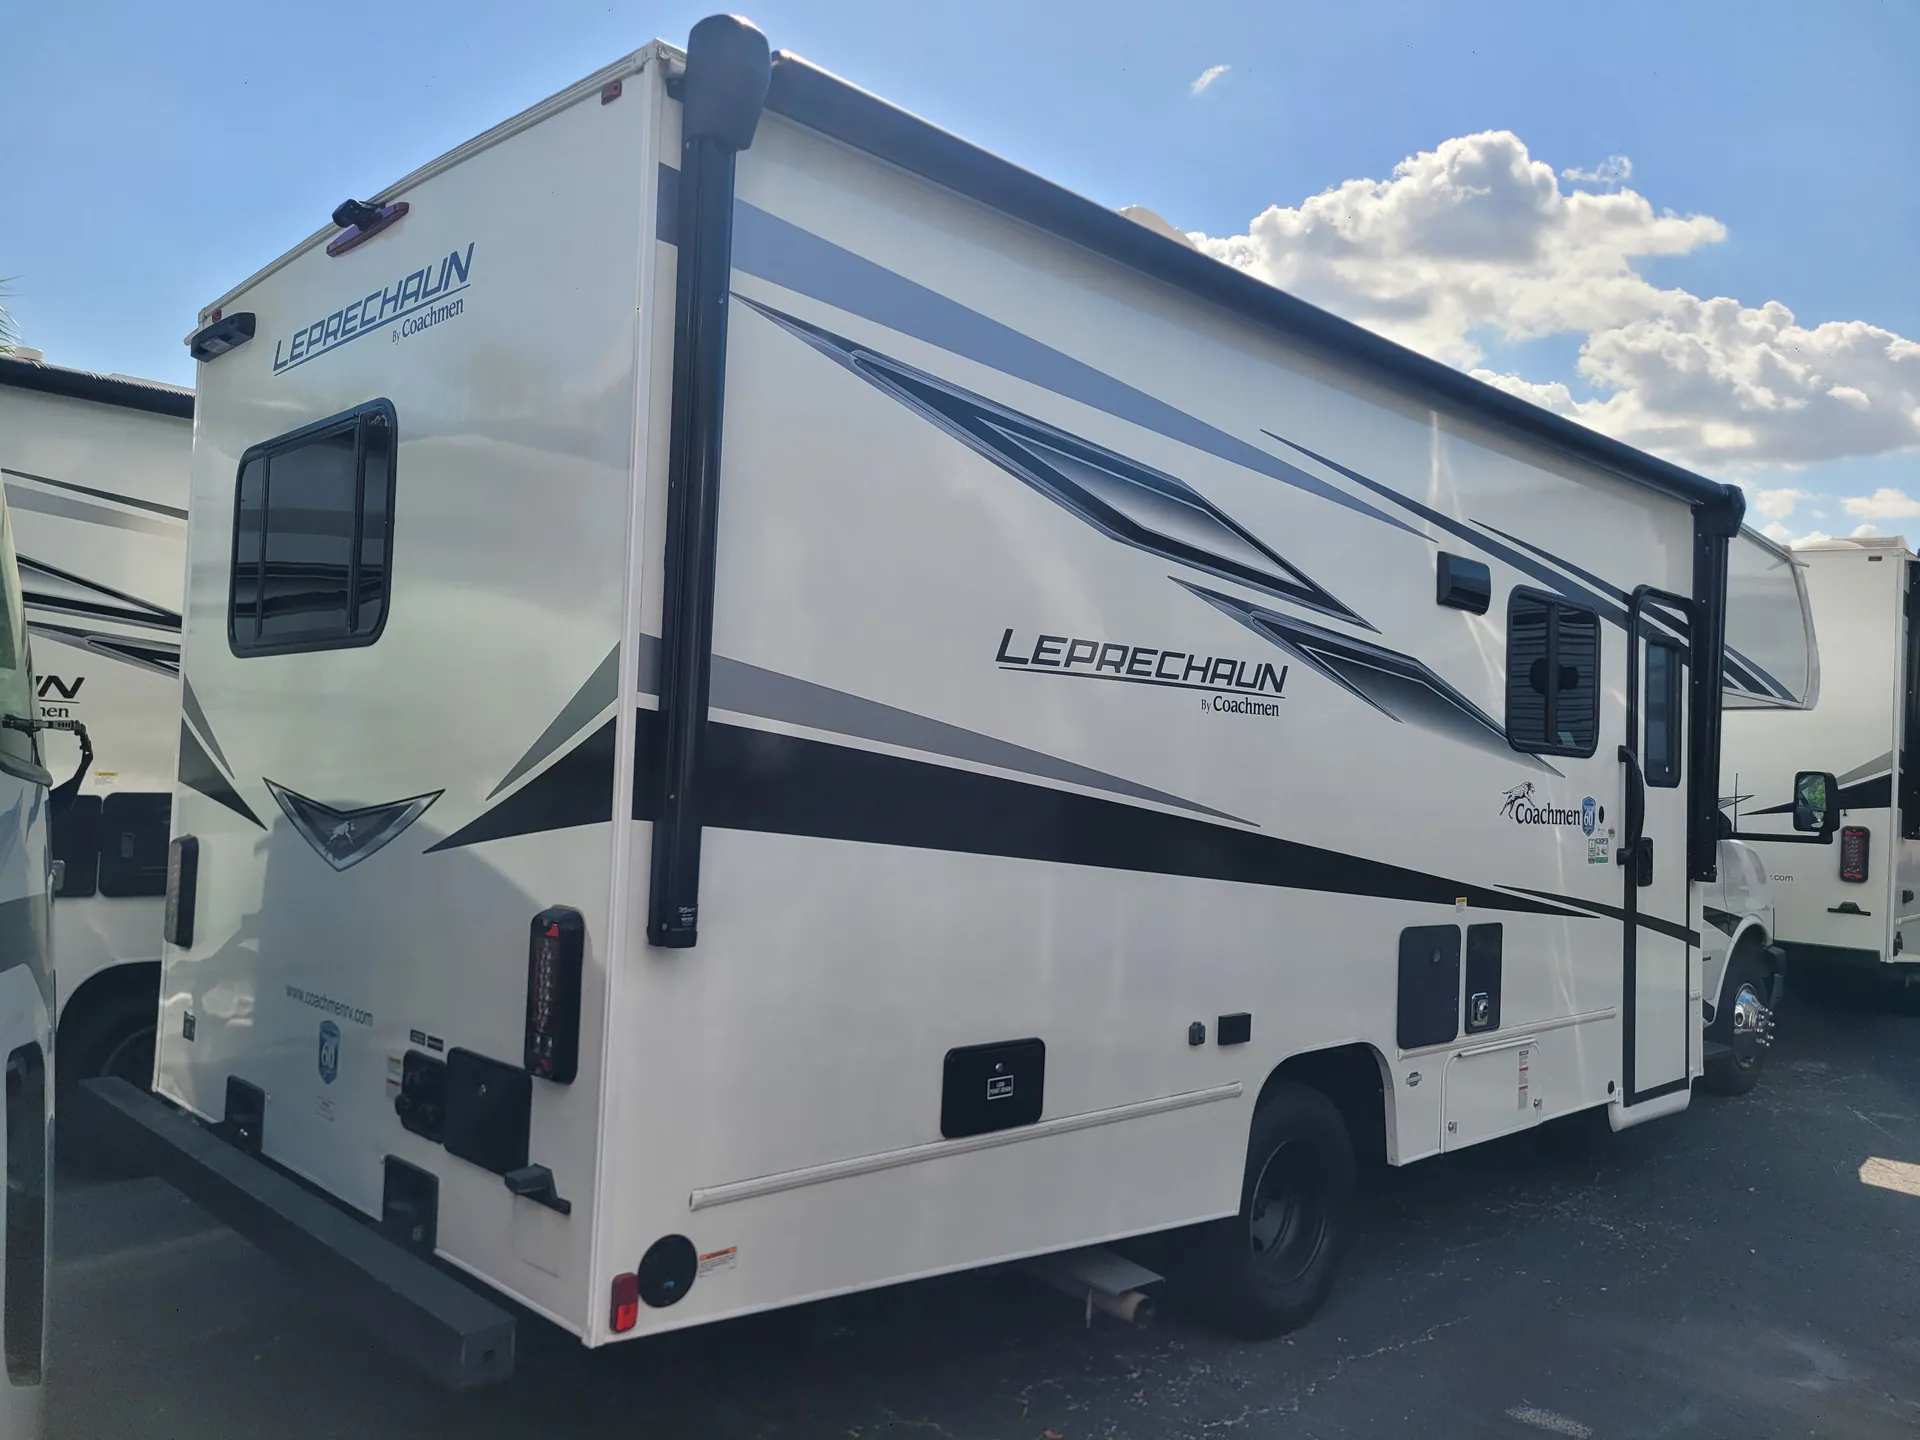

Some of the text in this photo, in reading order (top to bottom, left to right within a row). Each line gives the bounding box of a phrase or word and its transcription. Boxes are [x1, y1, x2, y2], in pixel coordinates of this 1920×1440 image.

[273, 242, 475, 372] LEPRECHAUN
[392, 298, 464, 345] By Coachmen
[995, 628, 1288, 693] LEPRECHAUN
[36, 675, 85, 699] N
[1201, 695, 1279, 717] By Coachmen
[1515, 802, 1581, 826] Coachmen
[285, 984, 373, 1027] www.coachmenrv.com
